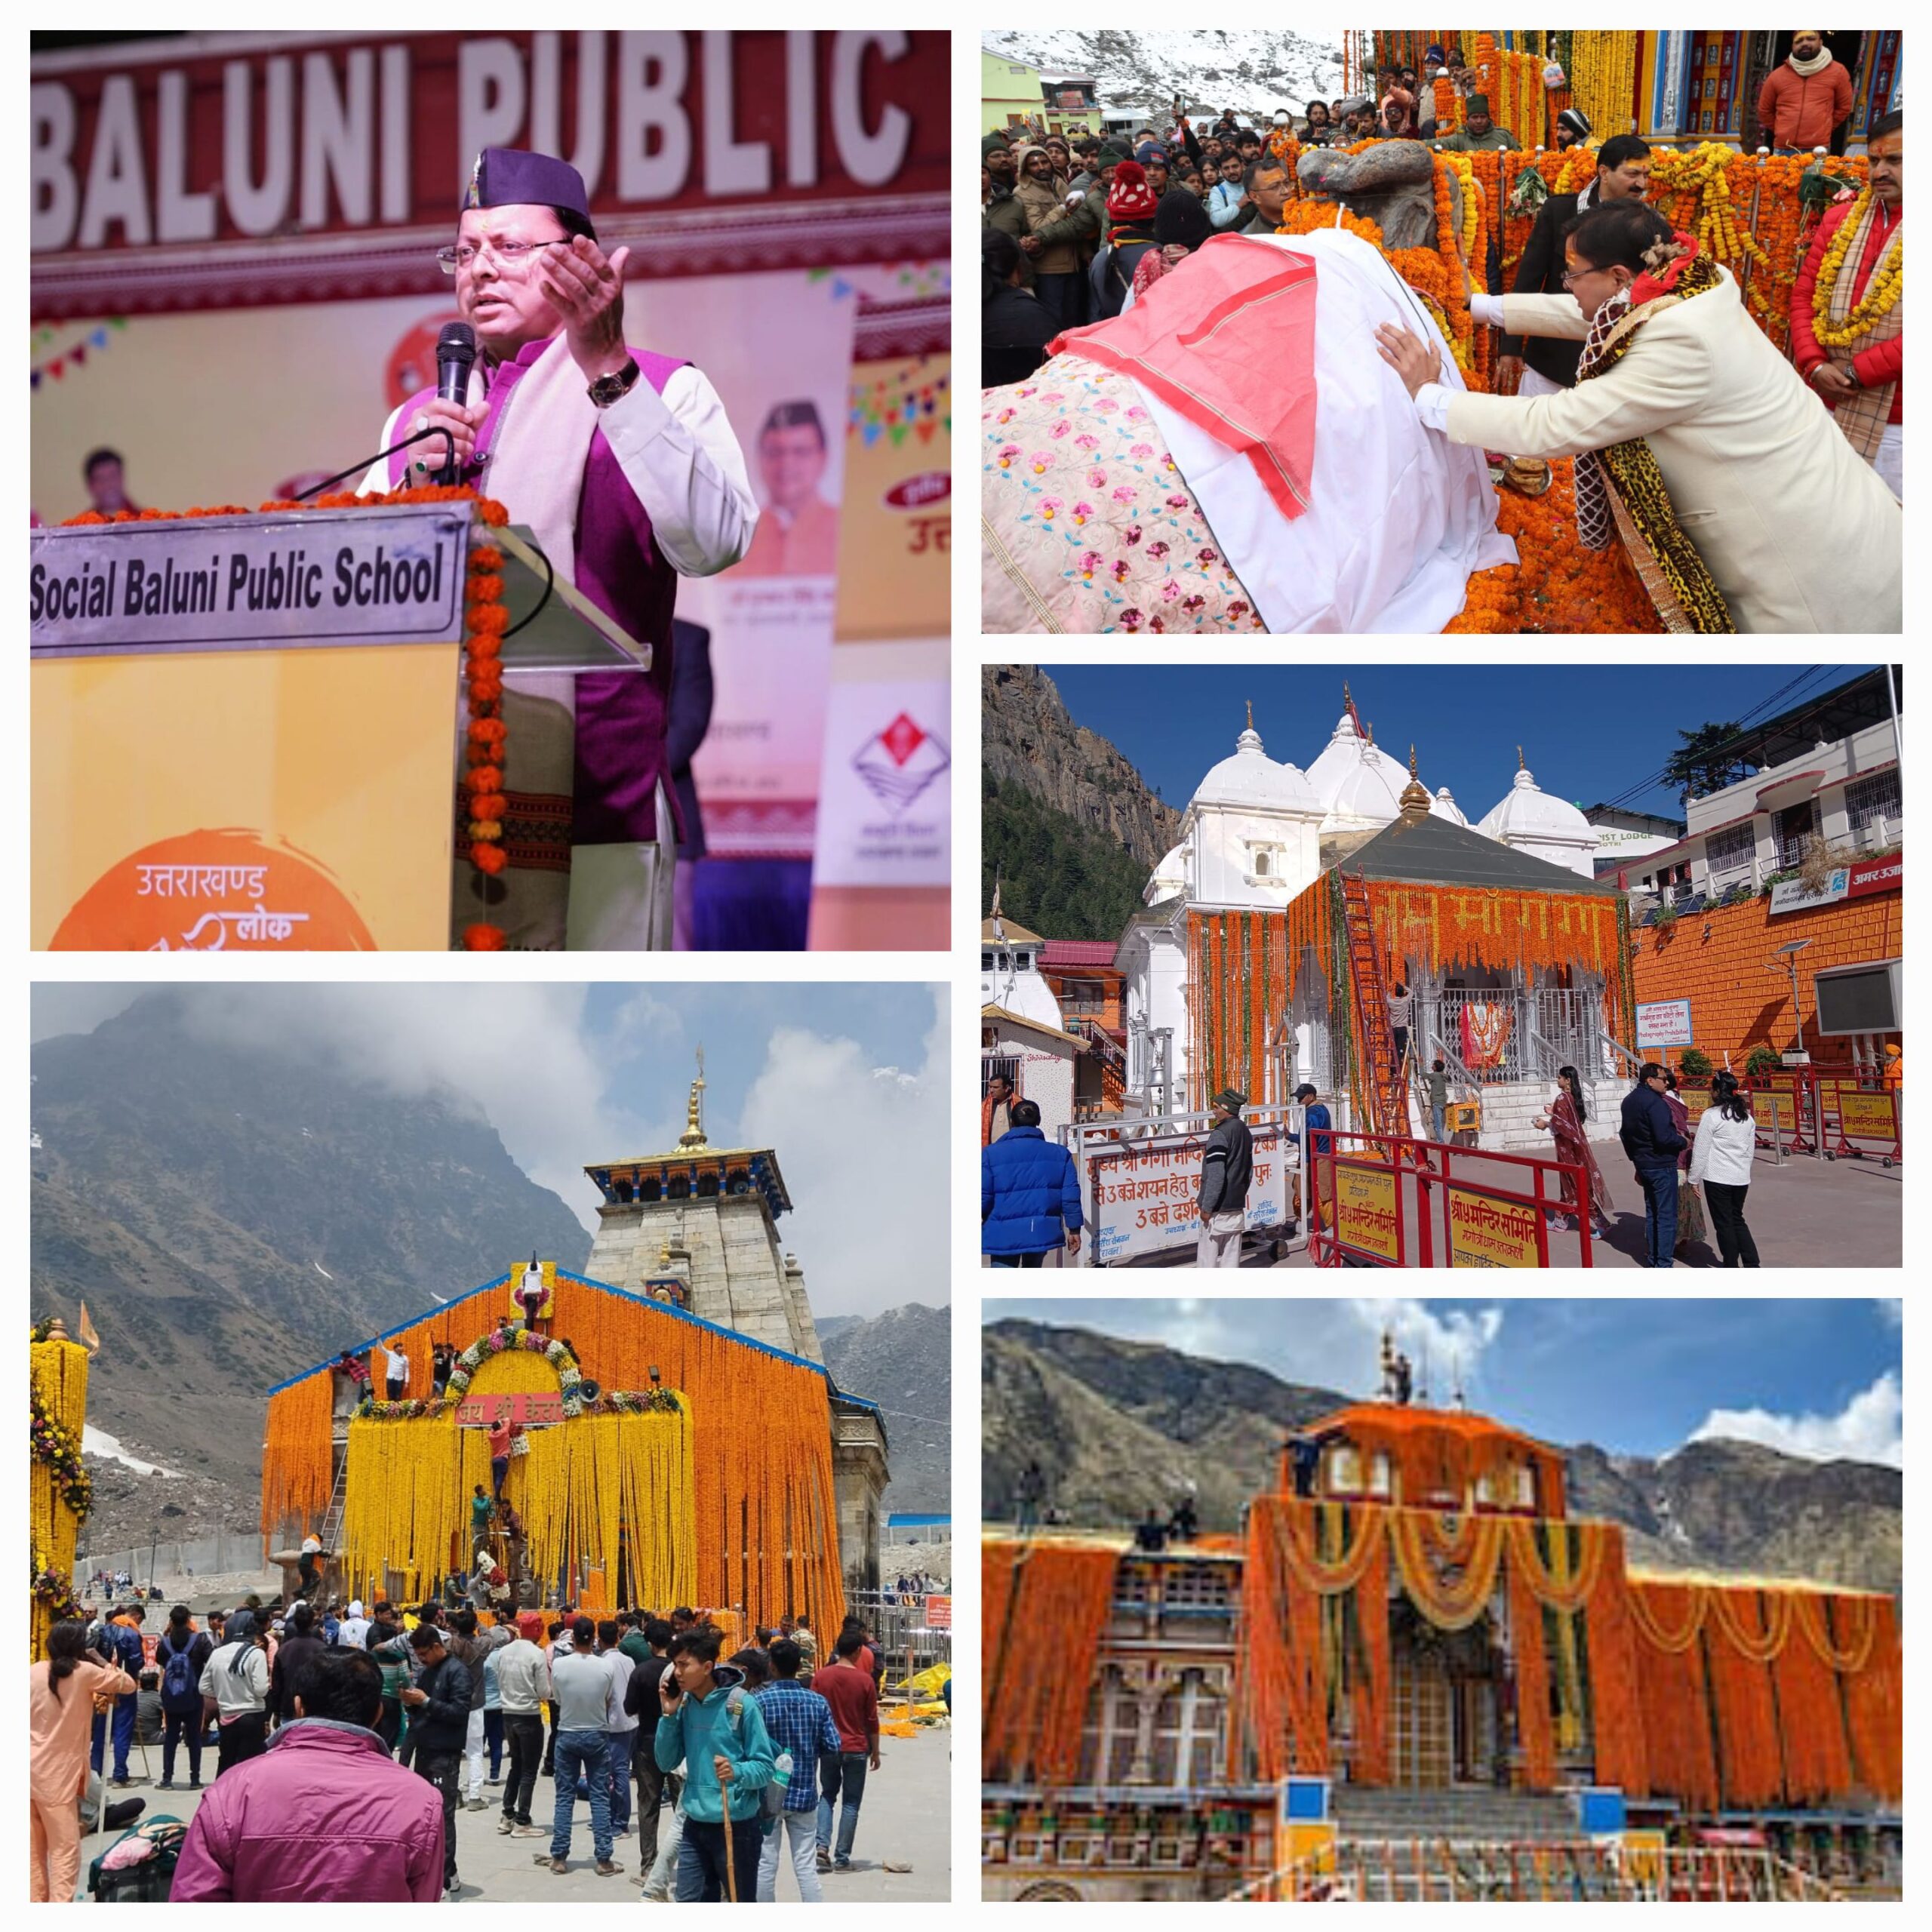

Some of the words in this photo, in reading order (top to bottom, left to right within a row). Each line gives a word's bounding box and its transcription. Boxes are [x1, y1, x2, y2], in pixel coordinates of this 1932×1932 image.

[30, 43, 411, 254] BALUNI
[458, 30, 911, 203] PUBLIC
[30, 561, 115, 620] Social
[123, 556, 219, 616] Baluni
[227, 550, 322, 611] Public
[333, 543, 444, 607] School
[1620, 832, 1654, 841] LODGE
[136, 865, 268, 898] उत्तराखण्ड
[1853, 870, 1878, 885] अमर
[232, 903, 310, 941] लोक
[1121, 1147, 1138, 1171] श्री
[1140, 1140, 1171, 1168] गंगा
[1261, 1130, 1278, 1152] बजे
[1117, 1178, 1136, 1202] बजे
[1137, 1178, 1168, 1199] शयन
[1170, 1172, 1189, 1198] हेतु
[1253, 1164, 1272, 1186] पुनः
[1147, 1201, 1170, 1226] बजे
[1469, 1200, 1503, 1233] मन्दिर
[1501, 1208, 1537, 1245] समिति
[459, 1402, 485, 1423] जय
